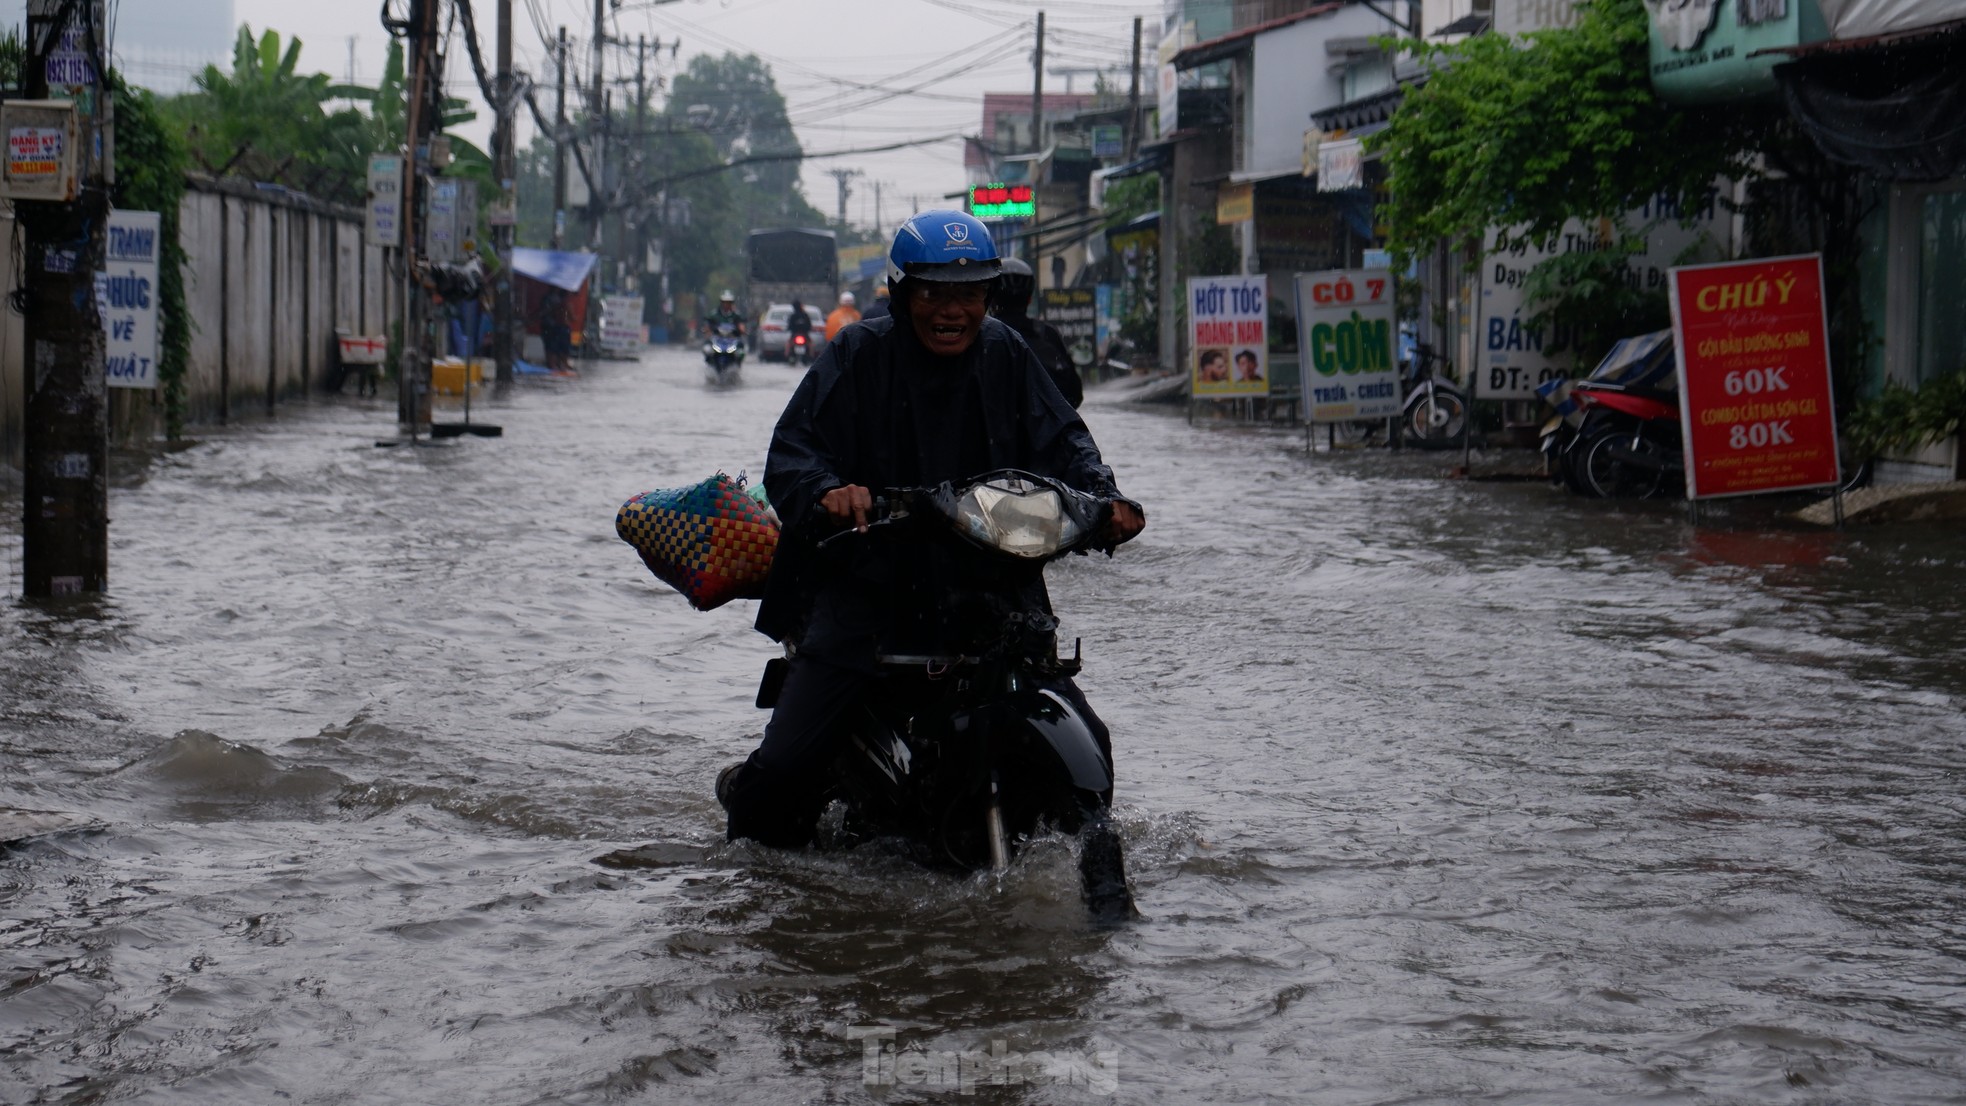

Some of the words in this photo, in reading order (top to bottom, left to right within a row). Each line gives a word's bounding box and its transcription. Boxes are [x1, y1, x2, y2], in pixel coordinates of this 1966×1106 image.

[19, 146, 40, 155] WIFI
[109, 226, 154, 257] TRANH
[106, 270, 151, 310] HÚC
[1196, 282, 1226, 315] HỚT
[1231, 281, 1262, 315] TÓC
[1313, 275, 1354, 304] CÔ
[1366, 279, 1386, 301] 7
[1695, 273, 1768, 313] CHÚ
[1775, 270, 1797, 305] Ý
[1237, 320, 1264, 345] NAM
[1312, 309, 1393, 376] CƠM
[1490, 367, 1528, 391] ĐT:
[1724, 365, 1789, 396] 60K
[1729, 420, 1794, 449] 80K
